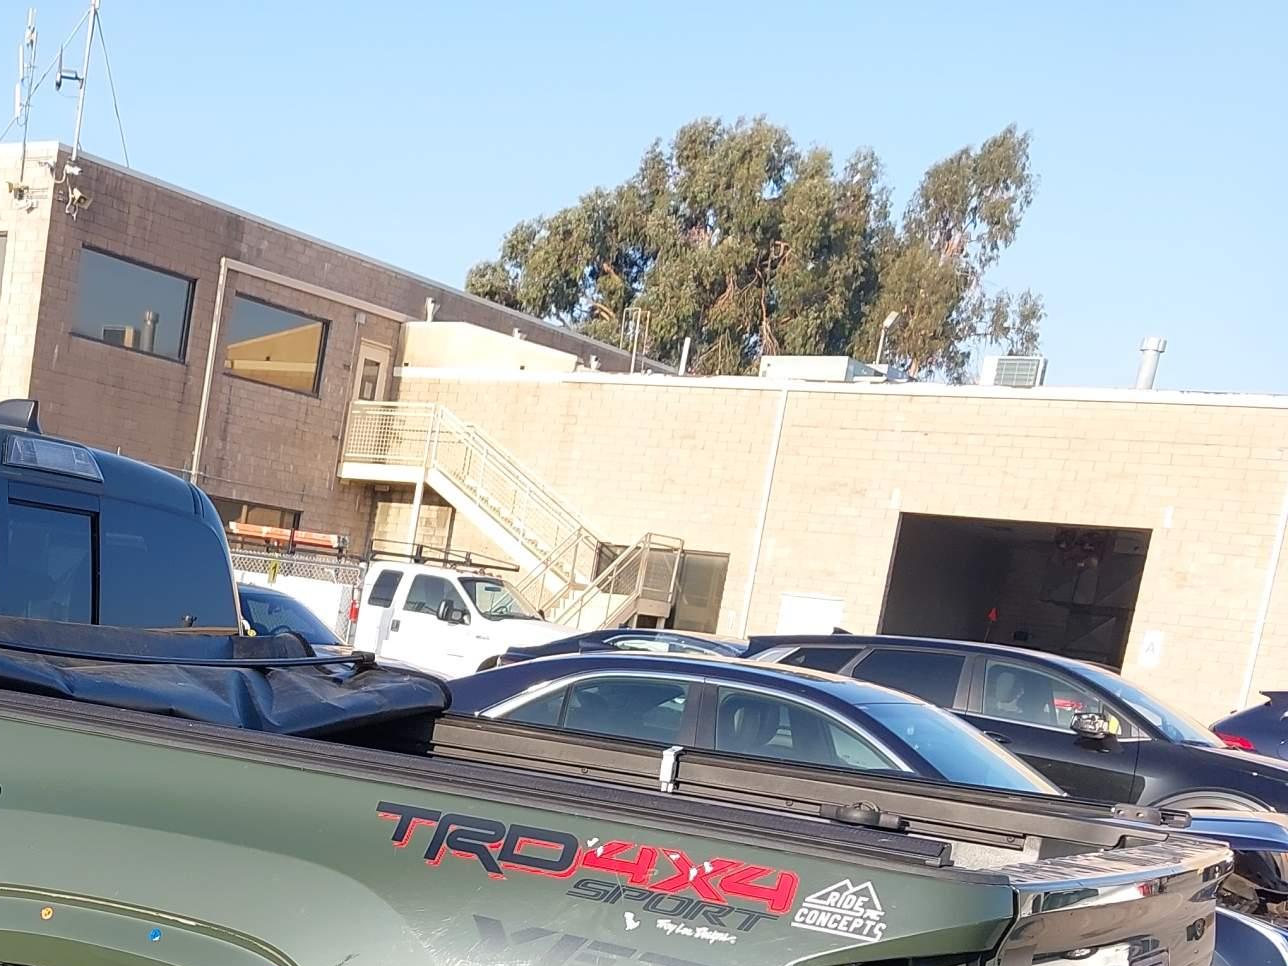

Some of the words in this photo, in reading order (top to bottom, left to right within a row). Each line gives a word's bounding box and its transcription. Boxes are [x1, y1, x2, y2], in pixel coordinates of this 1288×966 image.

[376, 800, 582, 880] TRD
[565, 878, 780, 932] SPORT
[794, 907, 887, 942] CONCEPTS
[826, 891, 870, 917] RIDE
